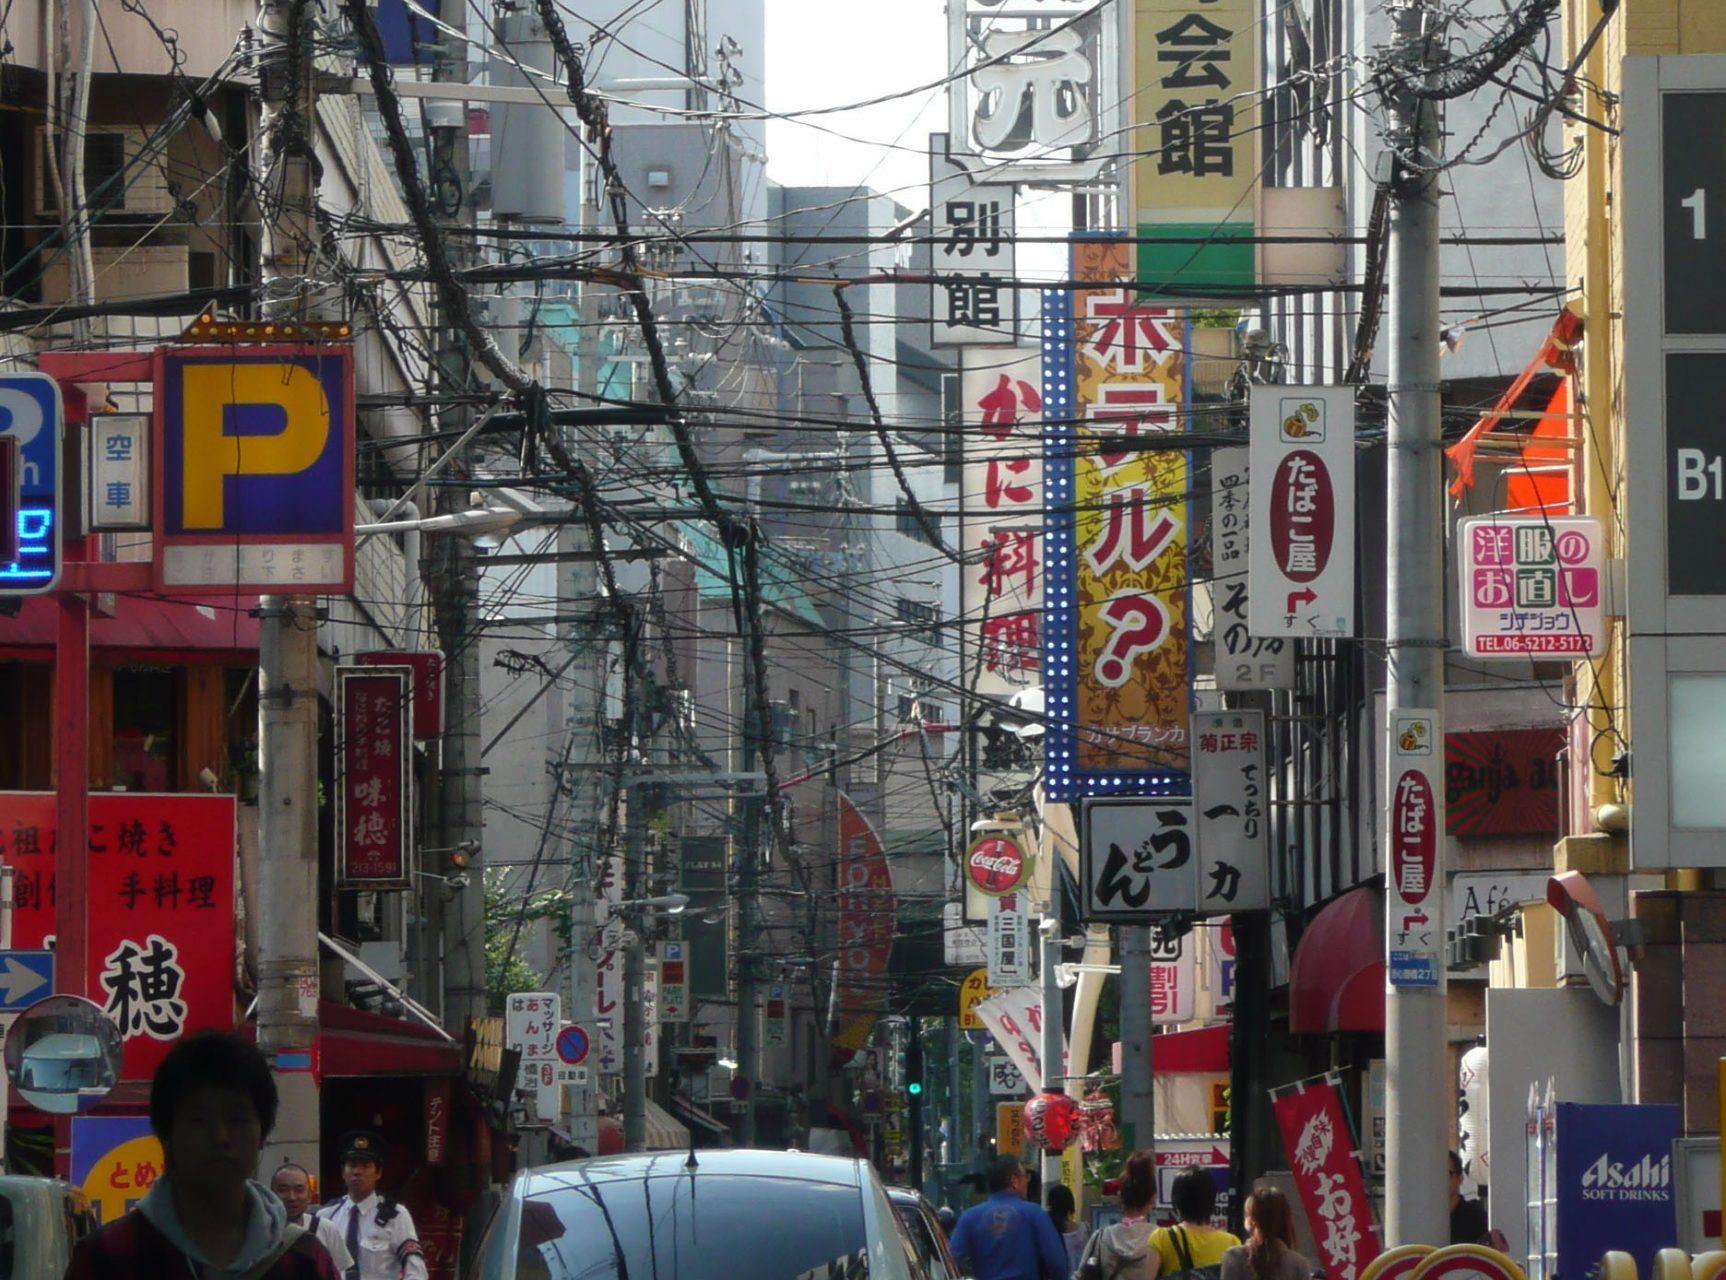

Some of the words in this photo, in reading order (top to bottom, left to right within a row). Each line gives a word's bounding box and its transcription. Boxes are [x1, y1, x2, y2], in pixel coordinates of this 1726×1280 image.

[942, 200, 1003, 330] 別館
[182, 363, 330, 530] P
[105, 433, 132, 510] 空車
[977, 374, 1042, 672] かに料理
[1218, 474, 1241, 562] 四季の一品
[1286, 456, 1319, 573] たばこ屋
[1476, 527, 1588, 564] 洋服の
[1476, 570, 1593, 605] お直し
[1235, 664, 1276, 683] 2F
[1085, 724, 1186, 744] カサブランカ
[1199, 733, 1259, 754] 菊正宗
[0, 818, 178, 859] 祖こ焼き
[1400, 775, 1427, 894] たばこ屋
[969, 850, 1022, 875] Coca-Cola
[1094, 808, 1191, 909] うどん
[117, 871, 217, 910] 手料理
[525, 998, 540, 1057] あんま
[541, 998, 555, 1056] マッサージ
[109, 1161, 165, 1189] とめ
[1581, 1152, 1671, 1189] Asahi
[1582, 1188, 1616, 1201] SOFT
[1619, 1189, 1670, 1202] DRINKS
